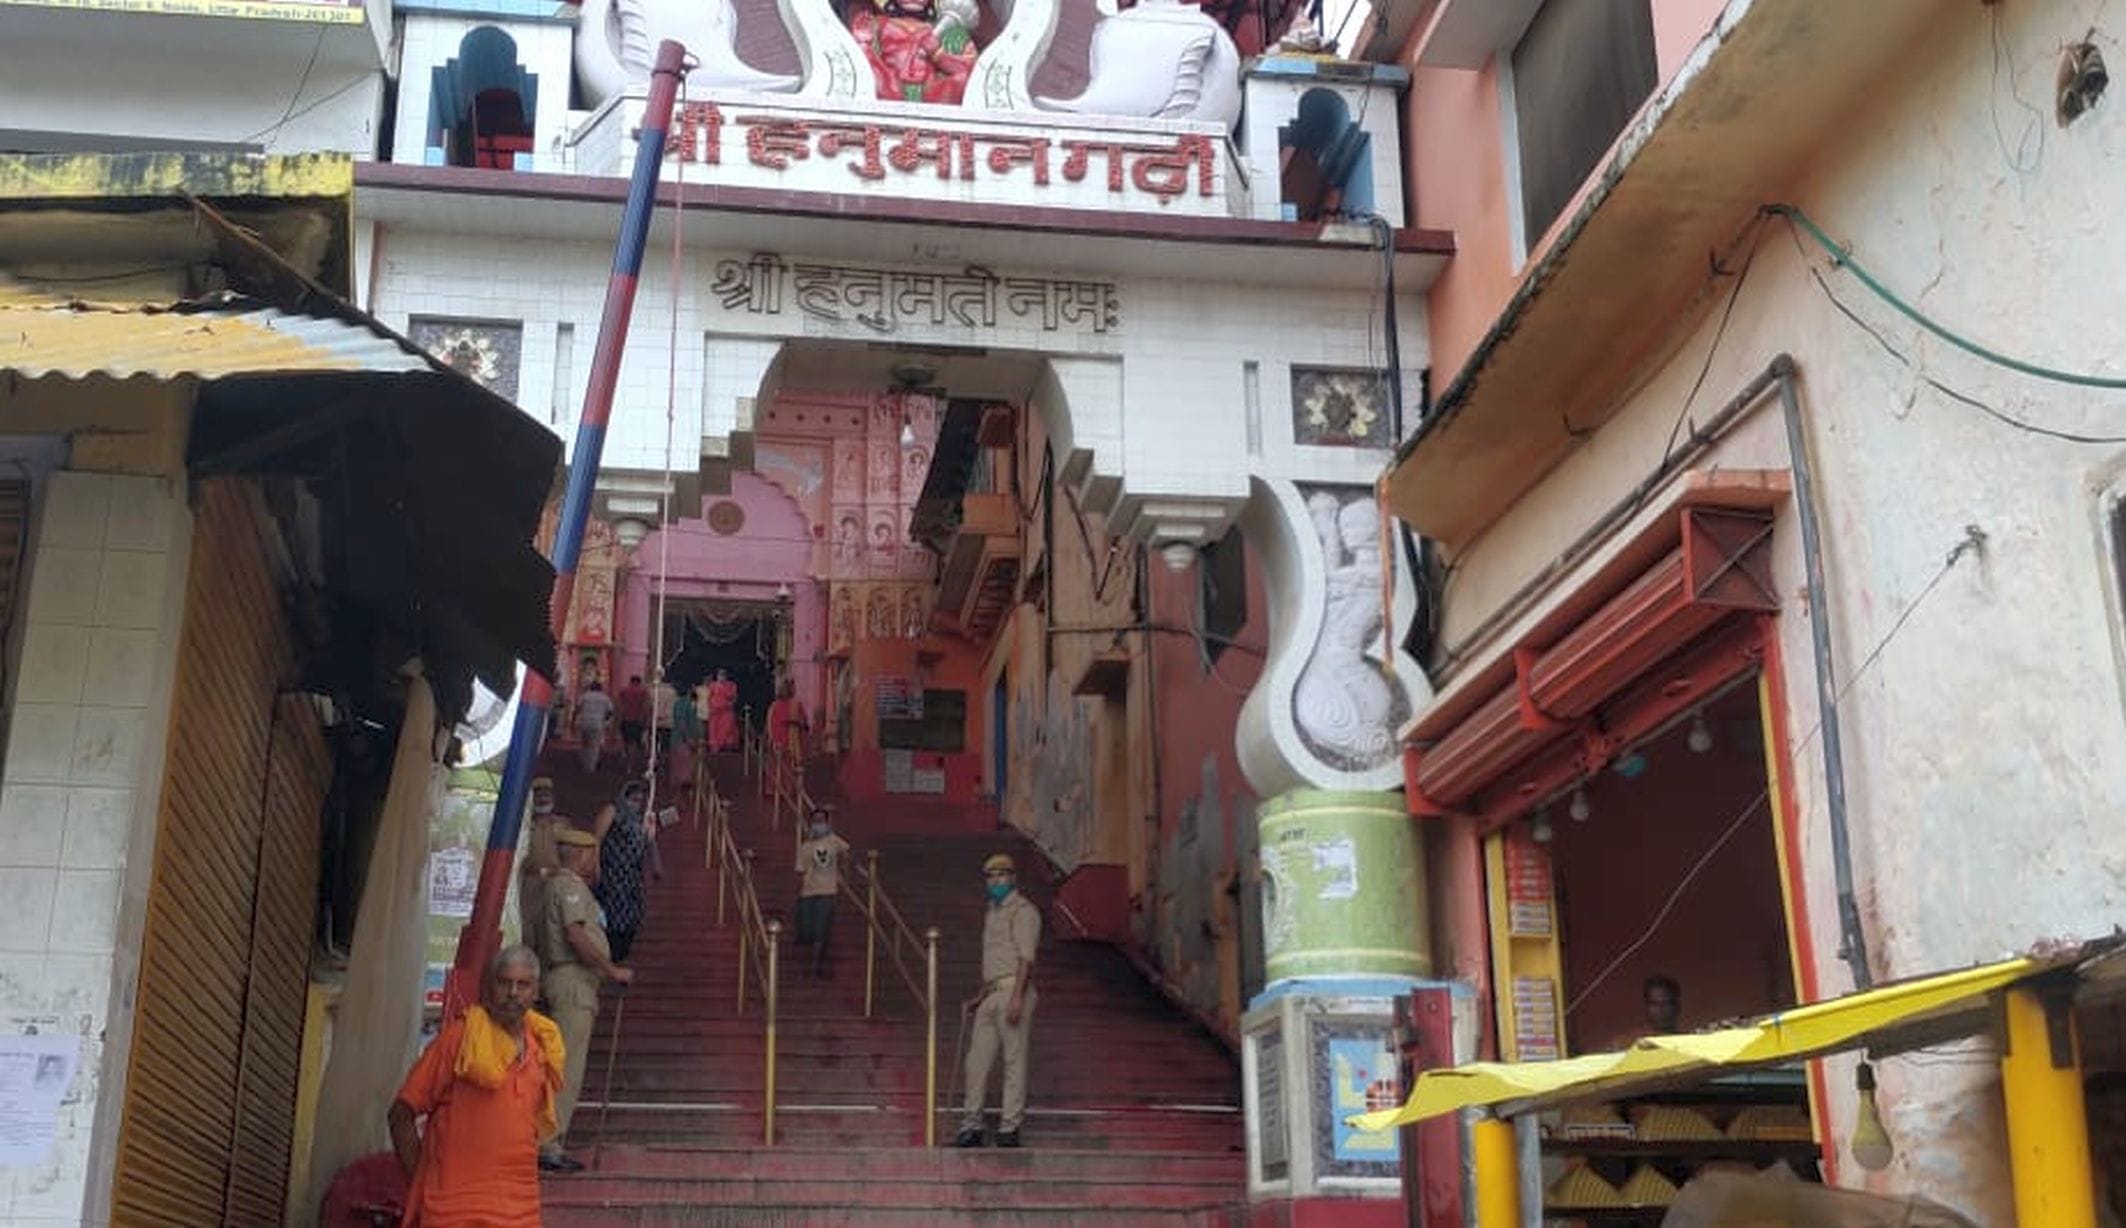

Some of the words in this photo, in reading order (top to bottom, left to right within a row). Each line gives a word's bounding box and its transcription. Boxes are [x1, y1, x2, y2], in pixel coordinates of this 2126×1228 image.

[711, 252, 788, 314] श्री
[794, 263, 1000, 333] हनुमते
[1005, 278, 1119, 332] नमः
